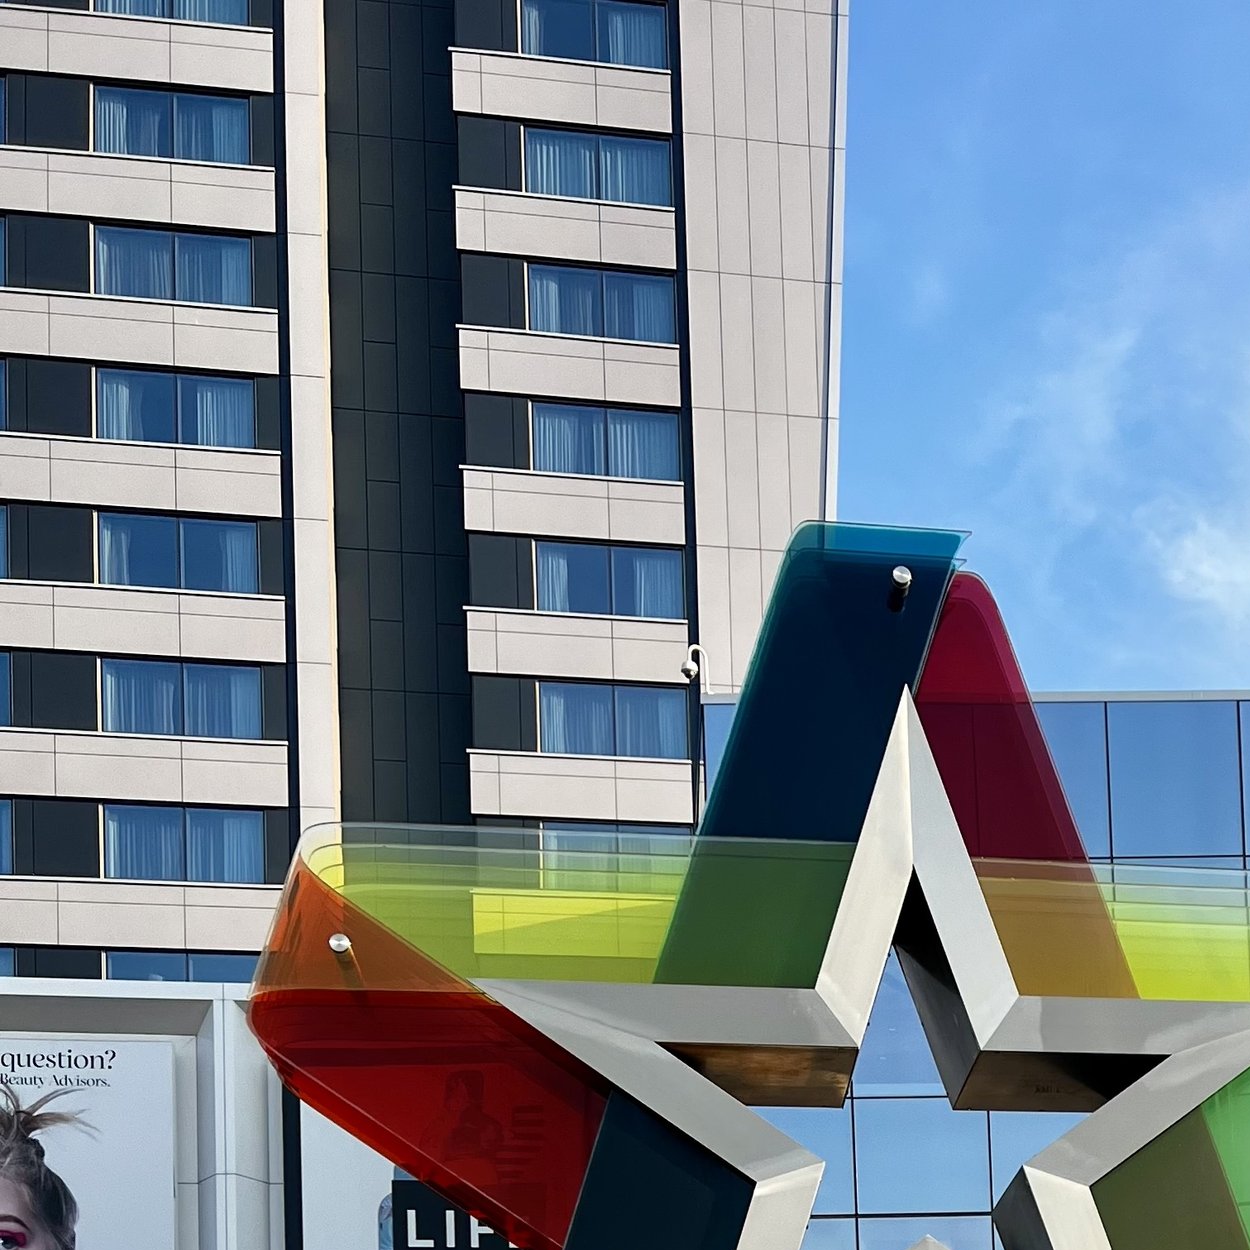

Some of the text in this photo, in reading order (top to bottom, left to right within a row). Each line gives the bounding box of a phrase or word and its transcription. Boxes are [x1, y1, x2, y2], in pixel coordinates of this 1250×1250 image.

[0, 1048, 117, 1073] question?
[0, 1073, 111, 1089] Beauty Advisors.
[406, 1209, 520, 1249] LIF
